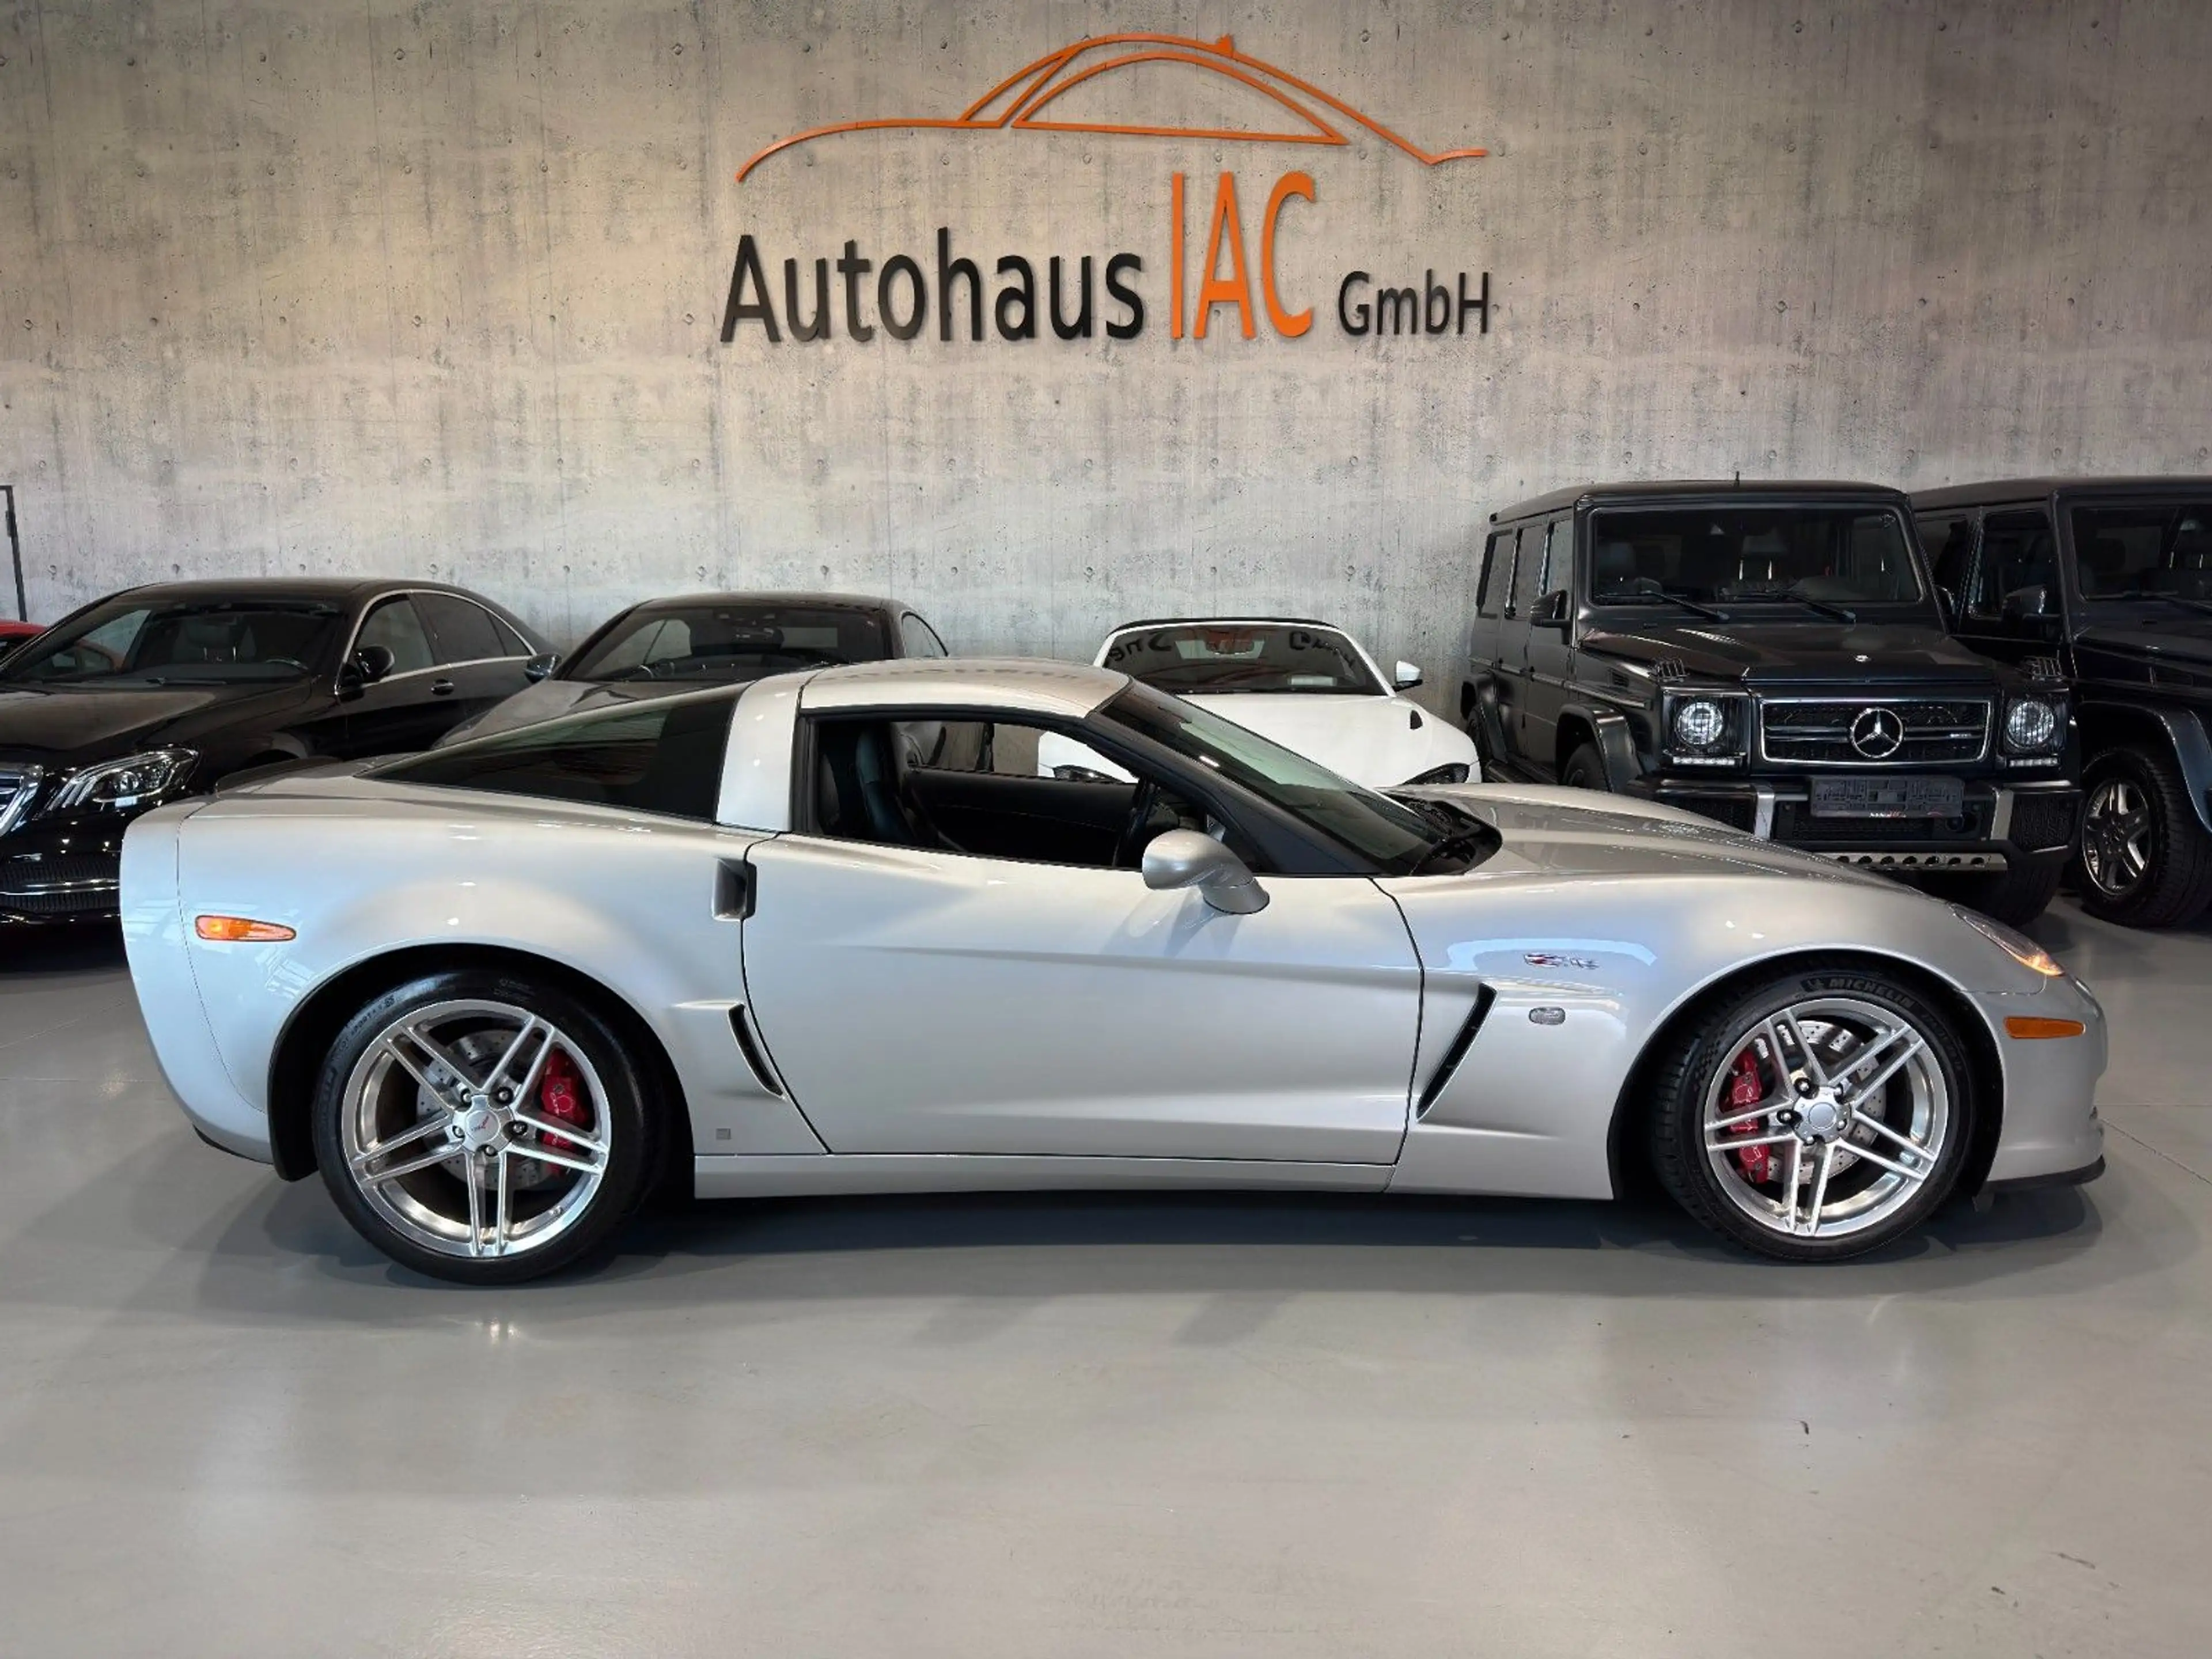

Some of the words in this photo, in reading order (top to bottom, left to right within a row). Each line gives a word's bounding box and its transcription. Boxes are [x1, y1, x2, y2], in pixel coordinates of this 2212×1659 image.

[720, 226, 1144, 342] Autohaus
[1172, 172, 1313, 339] IAC
[1338, 269, 1490, 337] GmbH
[1829, 978, 1916, 1007] MICHELIN
